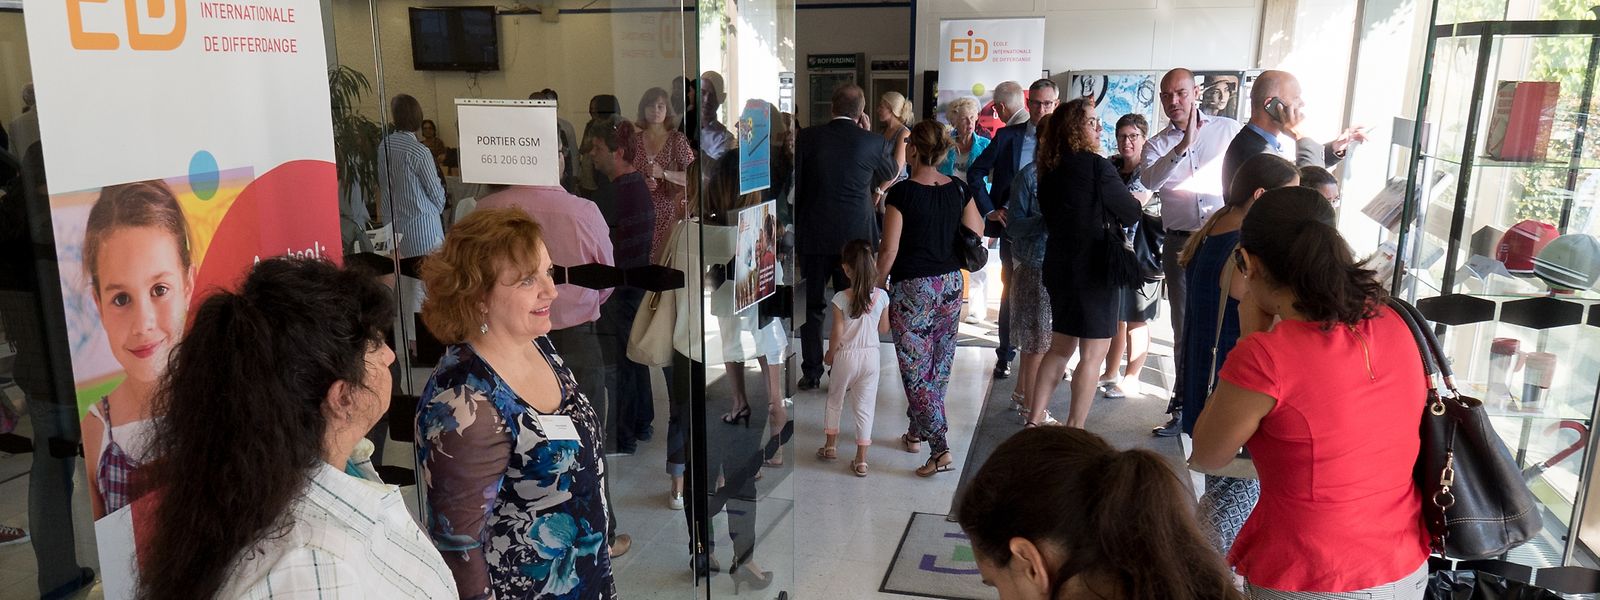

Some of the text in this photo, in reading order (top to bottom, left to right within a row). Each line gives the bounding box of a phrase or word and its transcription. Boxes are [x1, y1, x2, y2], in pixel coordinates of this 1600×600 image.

[200, 2, 295, 23] INTERNATIONALE
[204, 36, 297, 53] DE DIFFERDANGE
[477, 136, 541, 147] PORTIER GSM
[481, 154, 538, 165] 661 206 030
